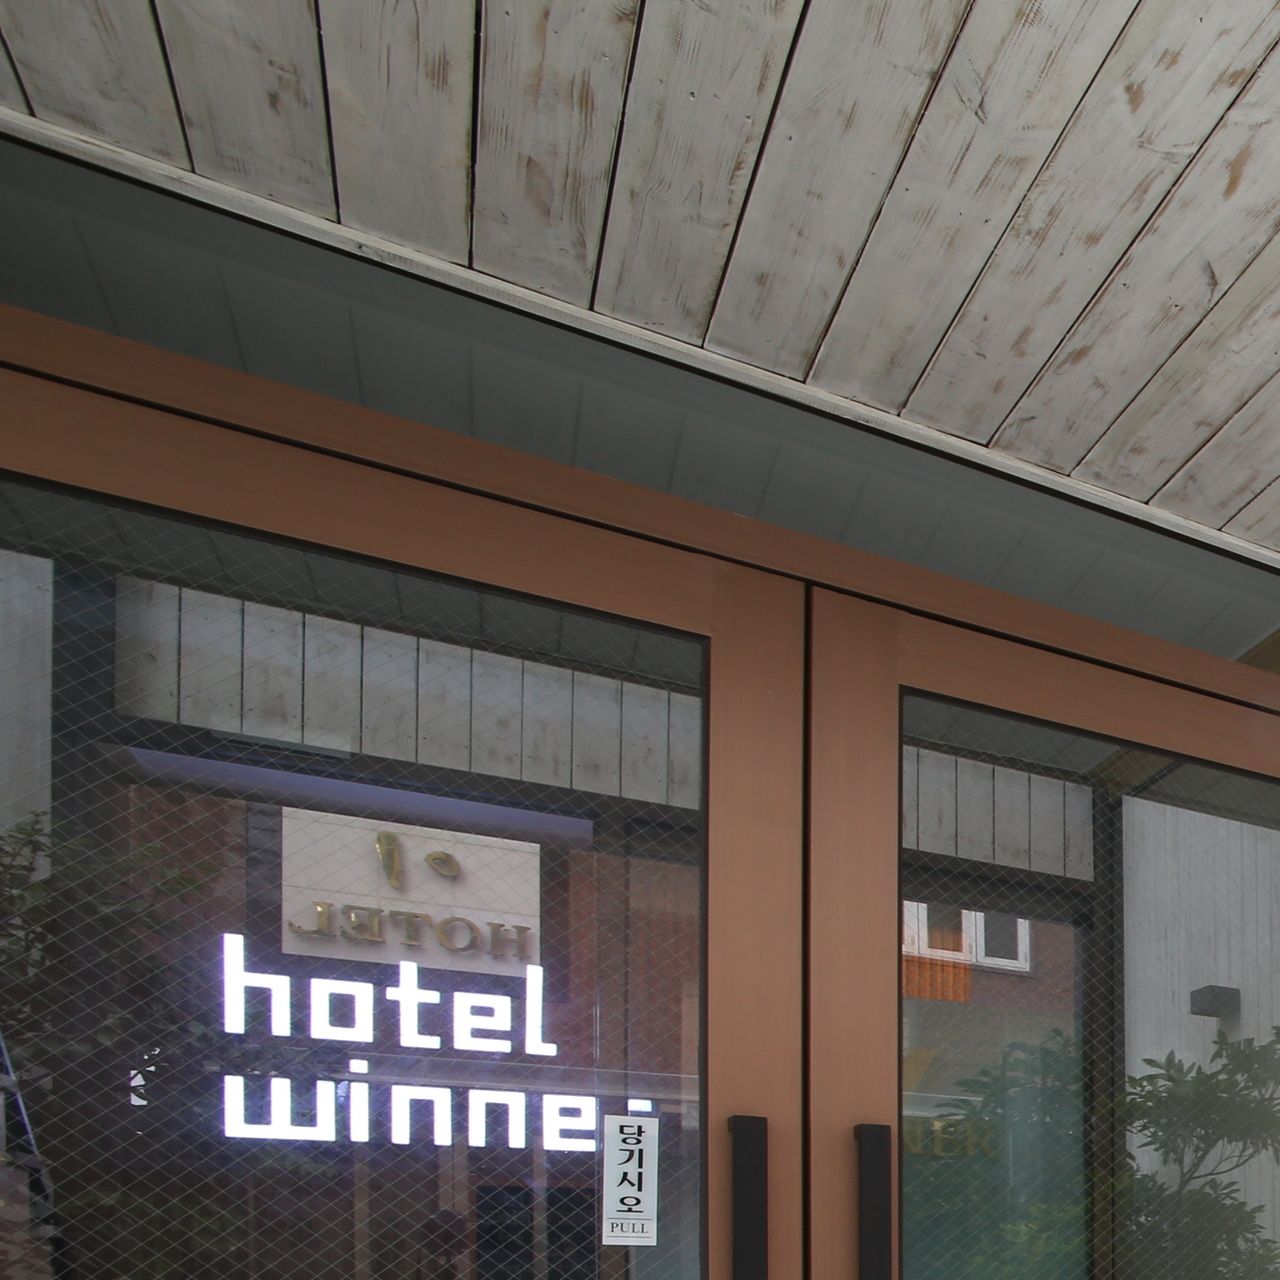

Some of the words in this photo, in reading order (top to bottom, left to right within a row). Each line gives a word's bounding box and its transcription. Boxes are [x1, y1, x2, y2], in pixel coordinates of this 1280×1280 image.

[222, 932, 558, 1057] hotel
[616, 1124, 646, 1214] 당기시오
[610, 1222, 649, 1234] PULL
